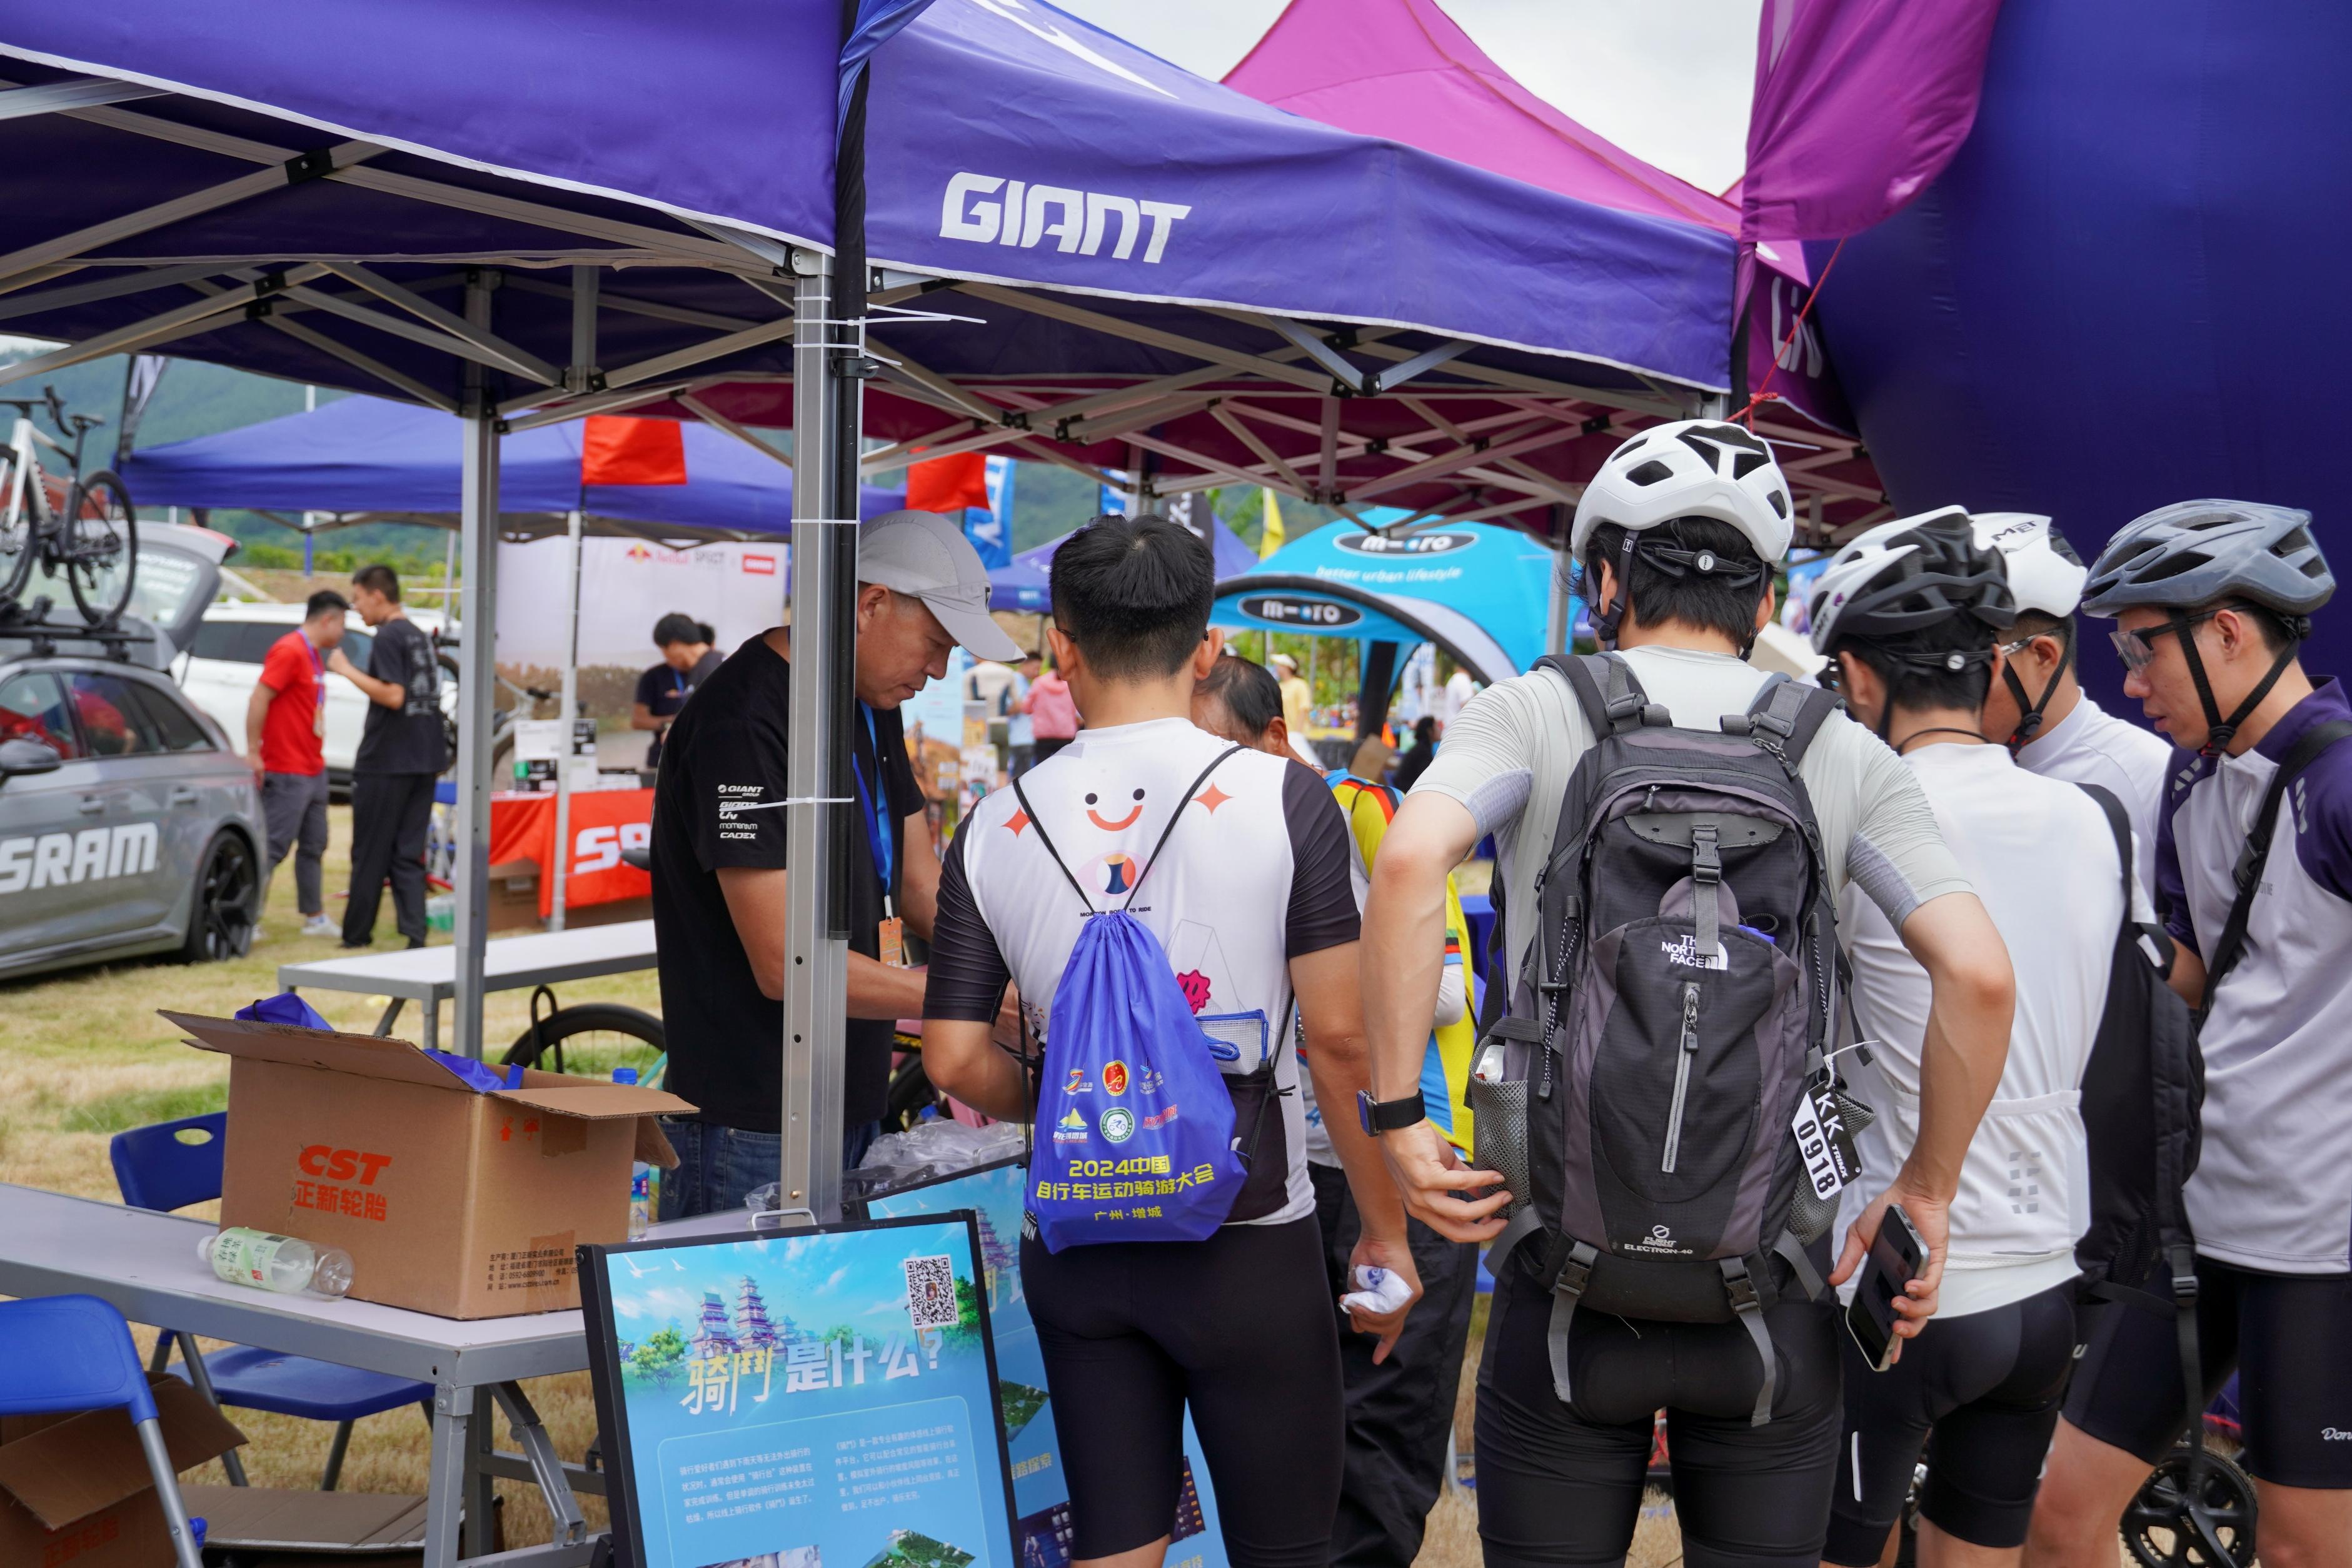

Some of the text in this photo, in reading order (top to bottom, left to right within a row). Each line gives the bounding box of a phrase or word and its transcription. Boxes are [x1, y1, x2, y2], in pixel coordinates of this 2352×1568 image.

[939, 172, 1192, 264] GIANT
[1991, 520, 2036, 541] MET
[1315, 565, 1462, 582] better urban lifestyle
[0, 822, 159, 894] SRAM
[1661, 942, 1697, 957] NORT
[1670, 953, 1705, 968] FACE
[298, 1145, 393, 1185] CST
[1069, 1155, 1170, 1177] 2024中国
[1797, 1119, 1836, 1193] 0918
[1832, 1143, 1848, 1179] TRINX
[1037, 1163, 1215, 1200] 自行车运动骑游大会
[294, 1180, 387, 1222] 正新轮胎
[1094, 1205, 1162, 1220] 广州·增城
